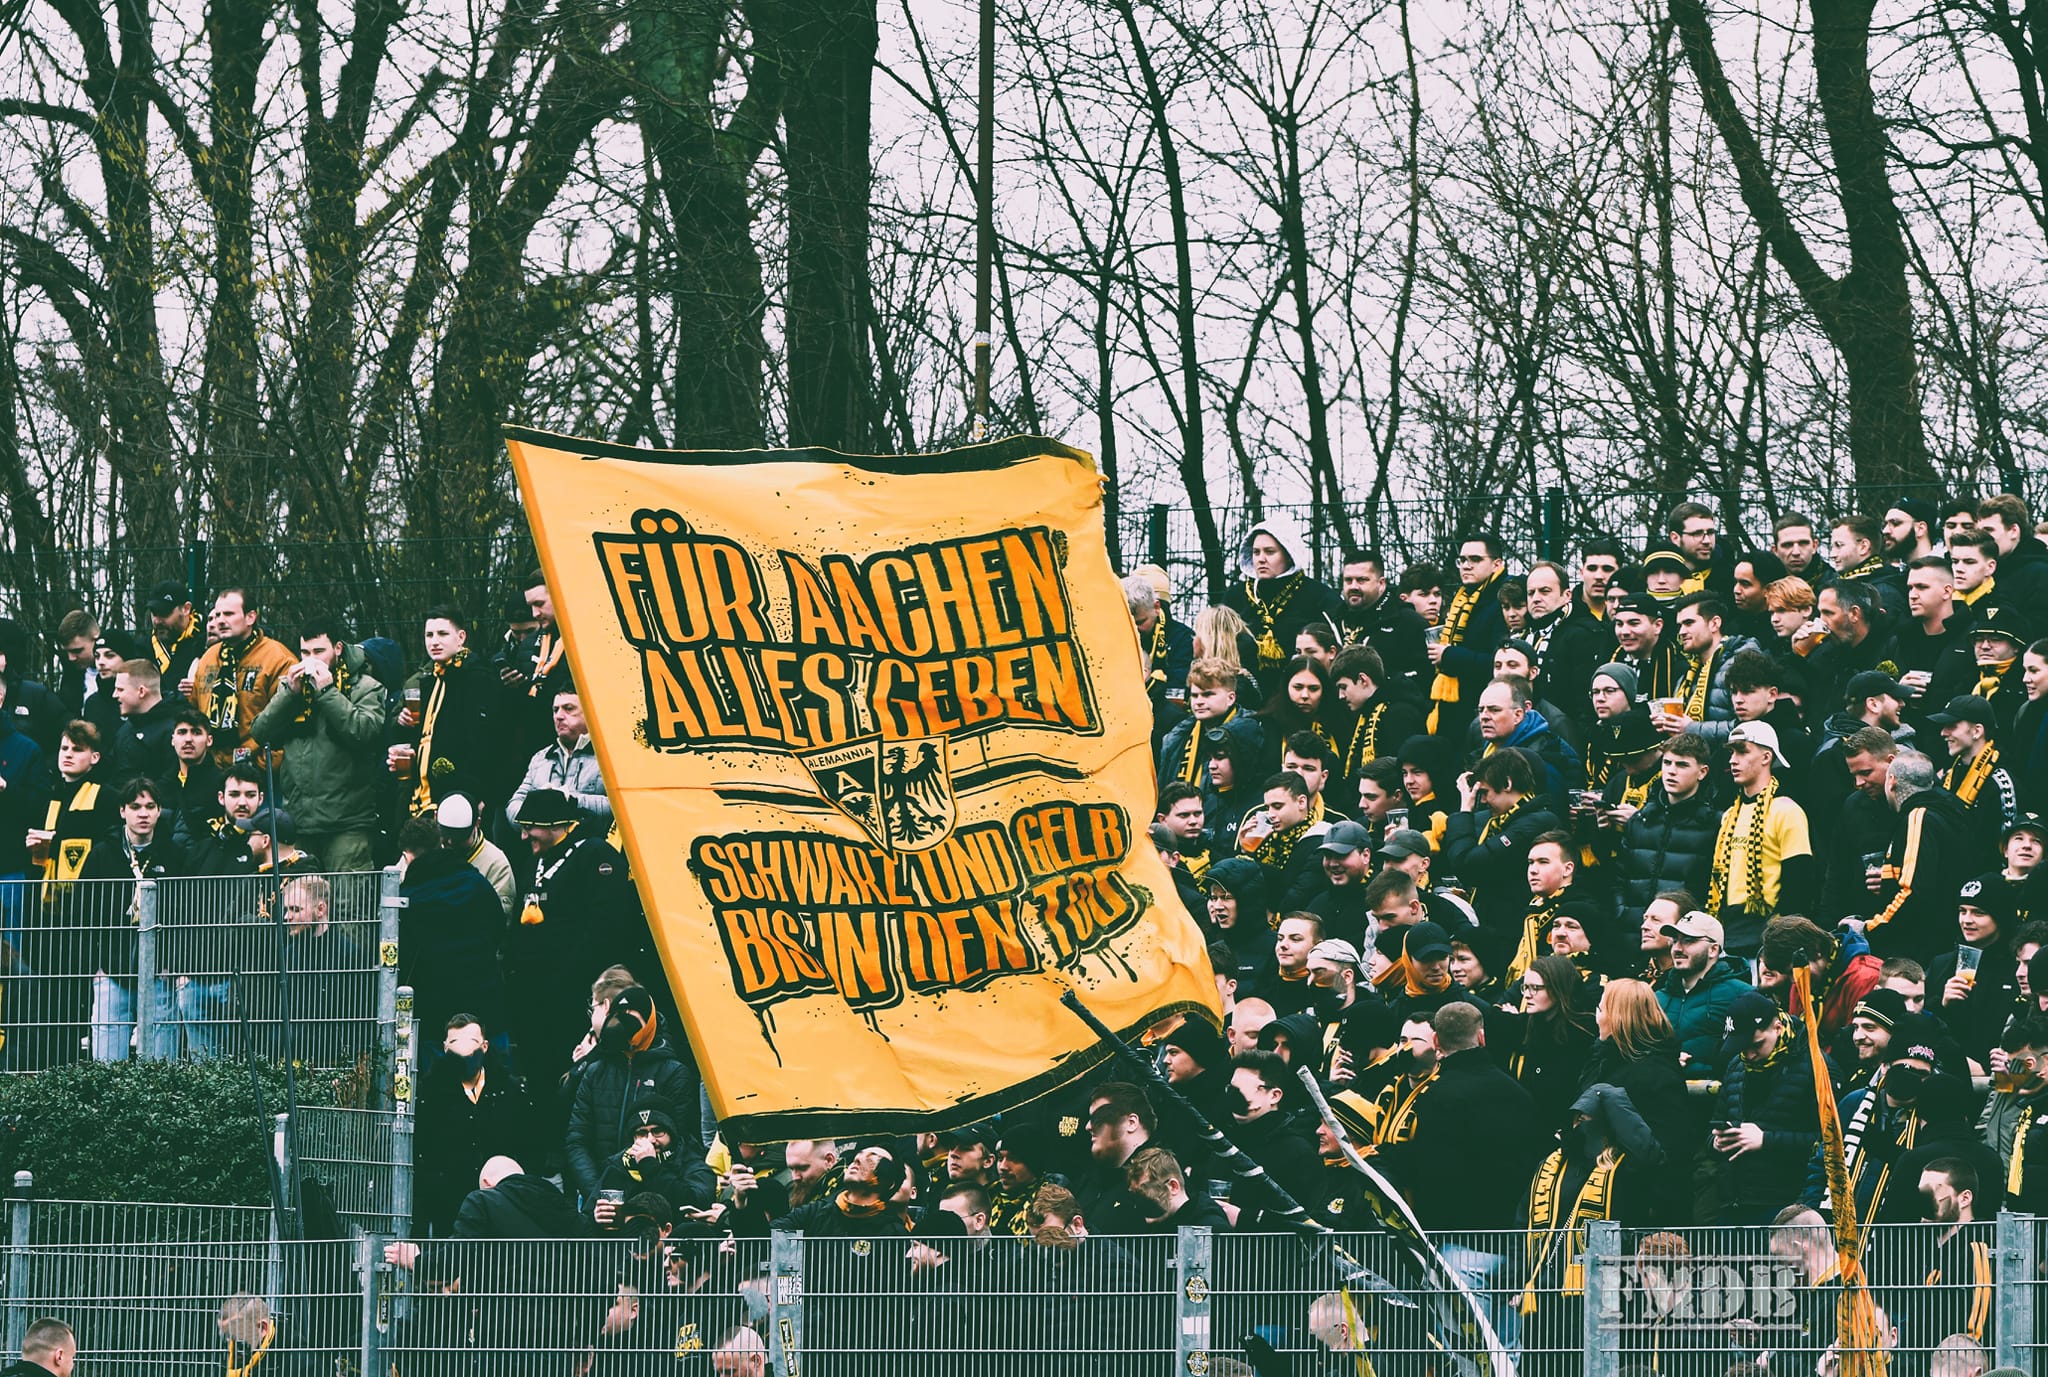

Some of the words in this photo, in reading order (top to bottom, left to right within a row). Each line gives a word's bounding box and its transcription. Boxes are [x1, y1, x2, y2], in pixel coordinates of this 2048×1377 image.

[600, 515, 768, 644] FÜR
[783, 530, 1068, 657] AACHEN
[644, 645, 848, 748] ALLES
[872, 640, 1090, 739] GEBEN
[807, 745, 874, 769] ALEMANNIA
[699, 839, 915, 906] SCHWARZ
[916, 828, 1019, 904] UND
[1015, 806, 1125, 876] GELB
[721, 906, 827, 995] BIS
[817, 911, 888, 999] IN
[902, 899, 1028, 985] DEN
